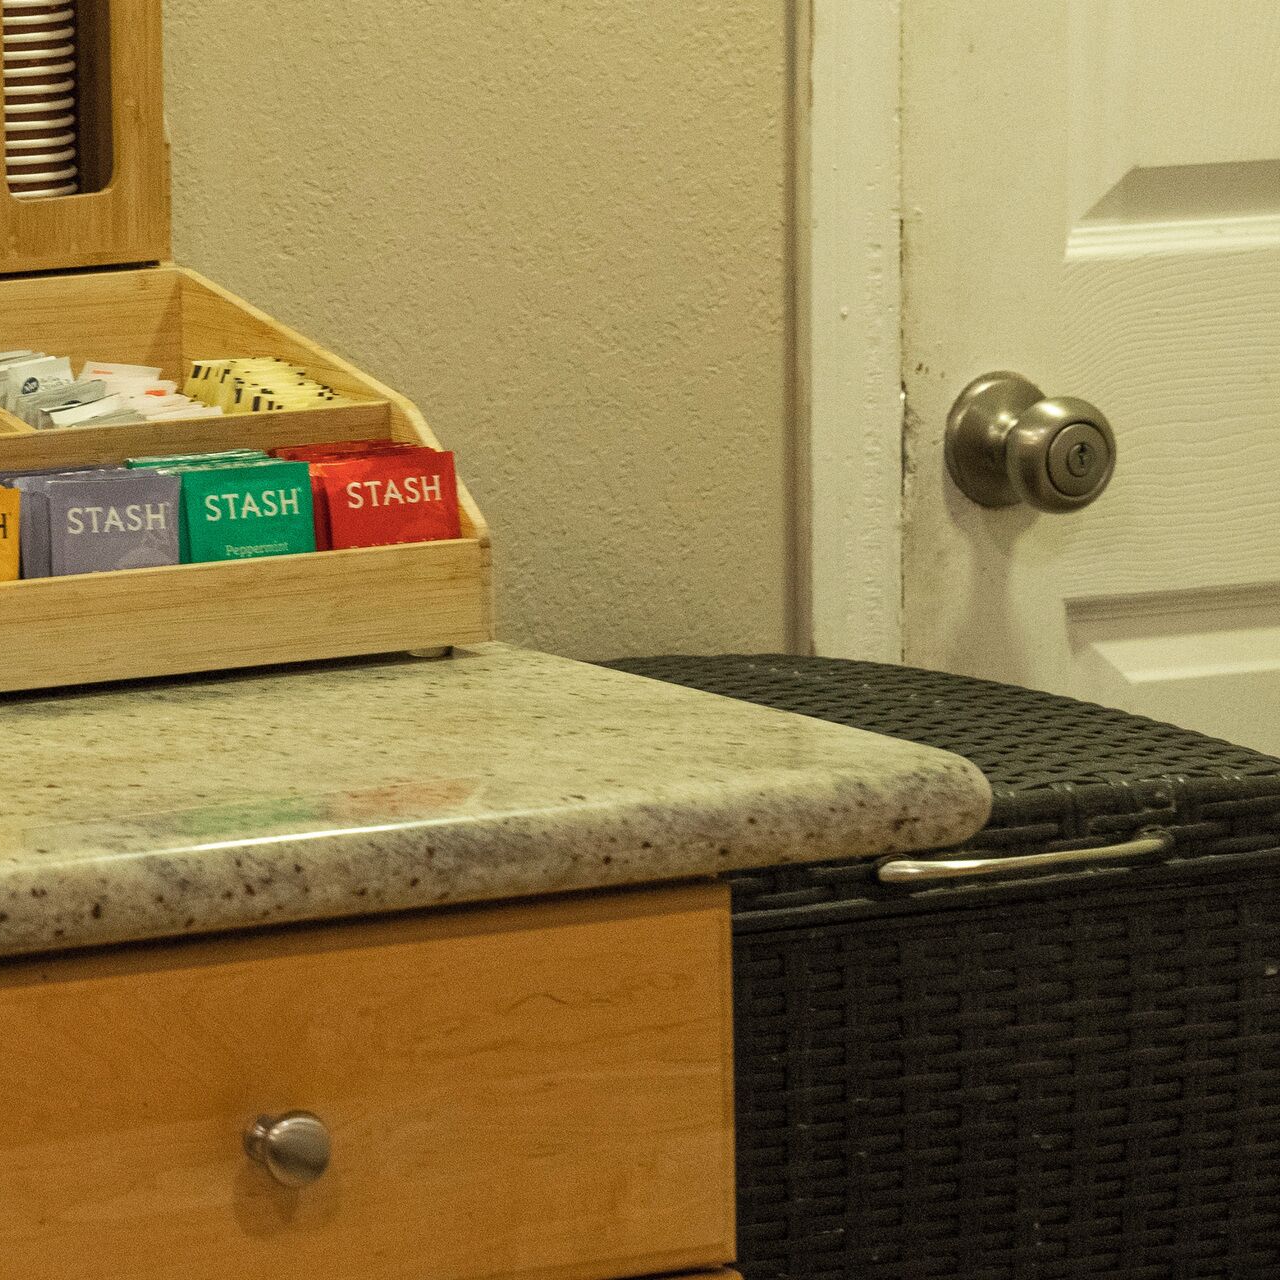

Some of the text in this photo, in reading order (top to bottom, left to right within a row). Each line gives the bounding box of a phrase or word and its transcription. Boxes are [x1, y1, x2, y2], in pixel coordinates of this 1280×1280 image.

[204, 487, 301, 522] STASH
[345, 474, 442, 510] STASH
[66, 502, 168, 536] STASH
[224, 541, 290, 558] Peppermint
